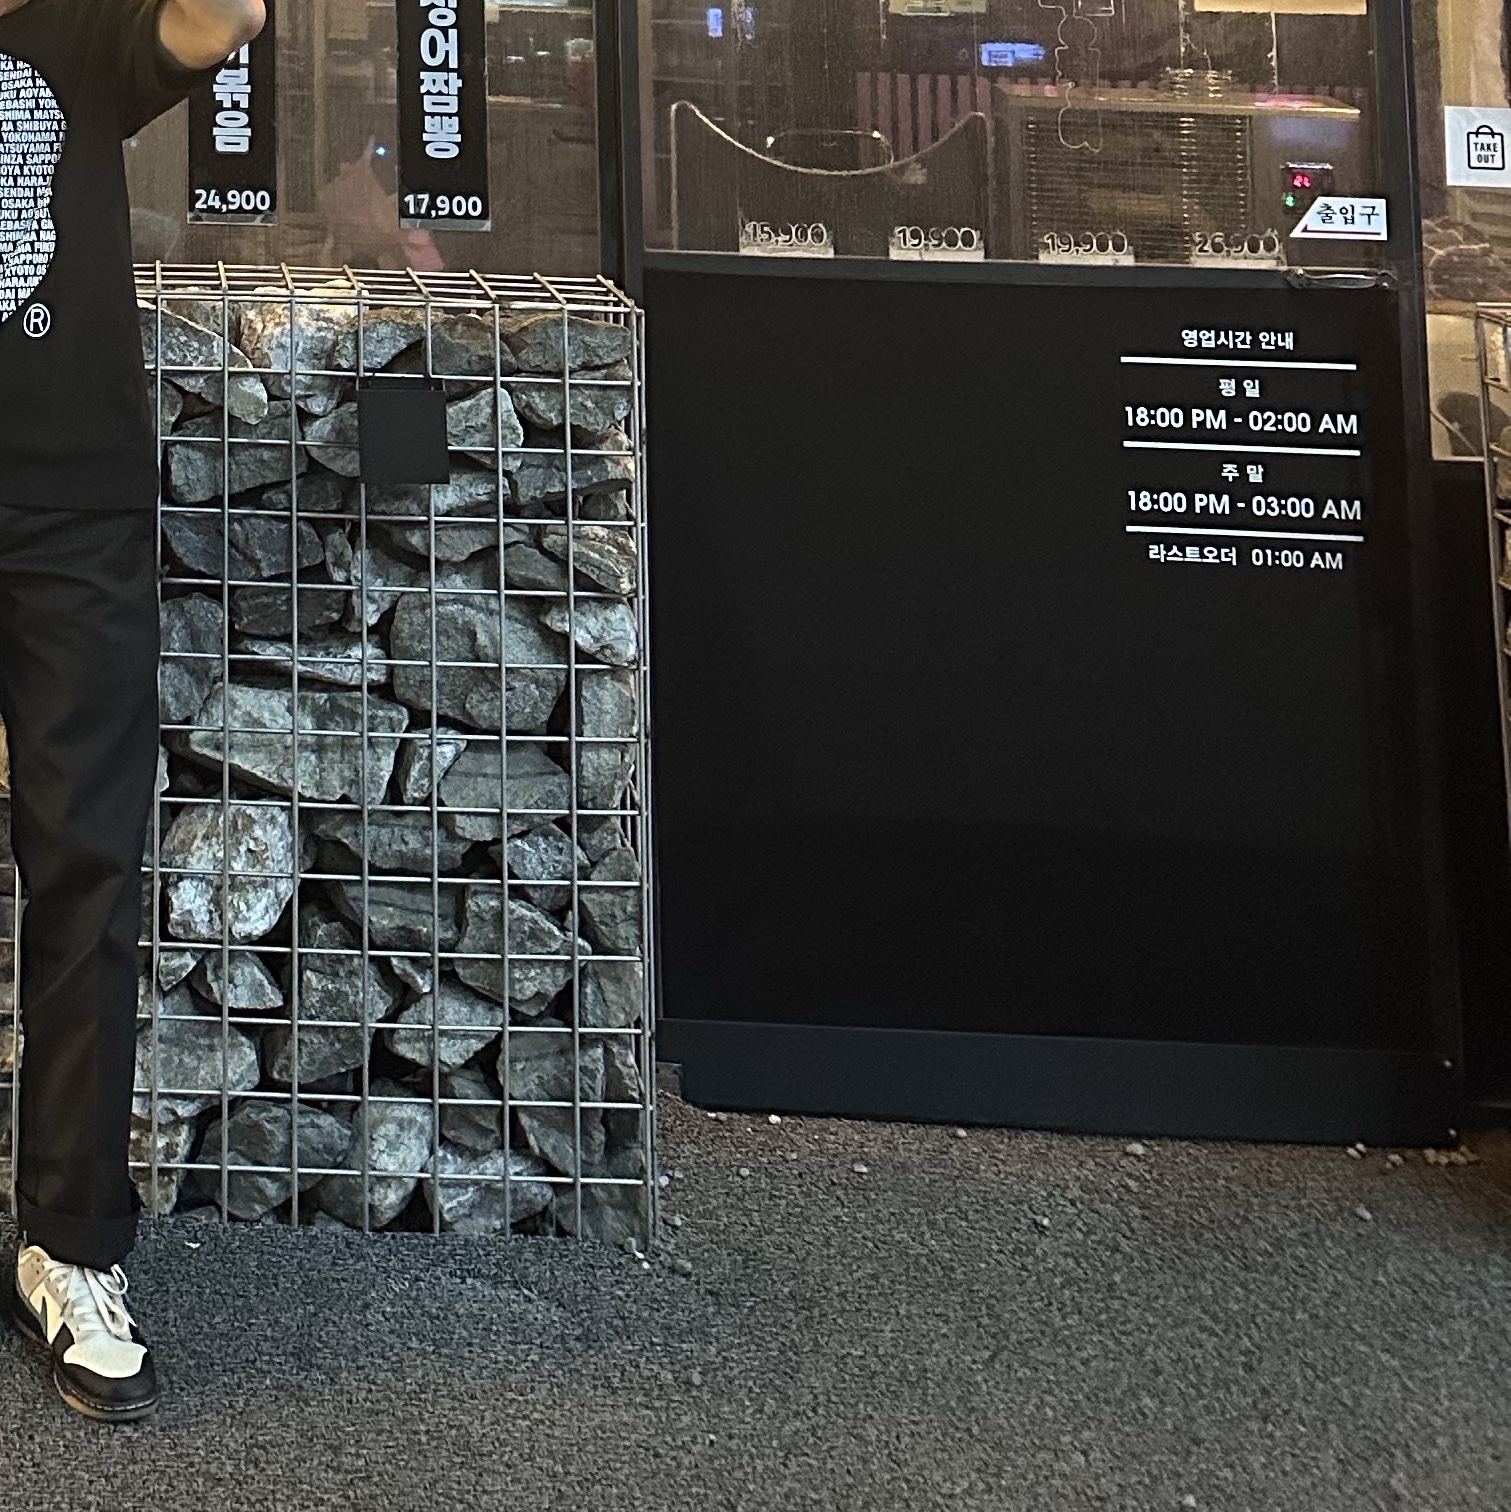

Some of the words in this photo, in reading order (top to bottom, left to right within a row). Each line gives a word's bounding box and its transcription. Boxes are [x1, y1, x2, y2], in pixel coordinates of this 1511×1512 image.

[1, 78, 33, 90] OSAKA
[16, 121, 59, 131] SHIBUYA
[2, 131, 56, 142] YOKOHAMA
[1473, 142, 1499, 153] TAKE
[1477, 154, 1496, 164] OUT
[23, 164, 54, 175] KYOTO
[1, 198, 34, 208] OSAKA
[194, 189, 271, 211] 24,900
[404, 194, 482, 218] 17,900
[1316, 202, 1380, 226] 출입구
[1181, 329, 1252, 349] 영업시간
[1259, 331, 1294, 351] 안내
[1124, 406, 1184, 428] 18:00
[1191, 409, 1227, 429] PM
[1248, 411, 1311, 433] 02:00
[1318, 414, 1358, 434] AM
[1127, 490, 1186, 513] 18:00
[1194, 493, 1230, 514] PM
[1252, 496, 1314, 518] 03:00
[1322, 499, 1362, 520] AM
[1148, 544, 1237, 566] 라스트오더
[1251, 549, 1304, 568] 01:00
[1310, 551, 1343, 570] AM
